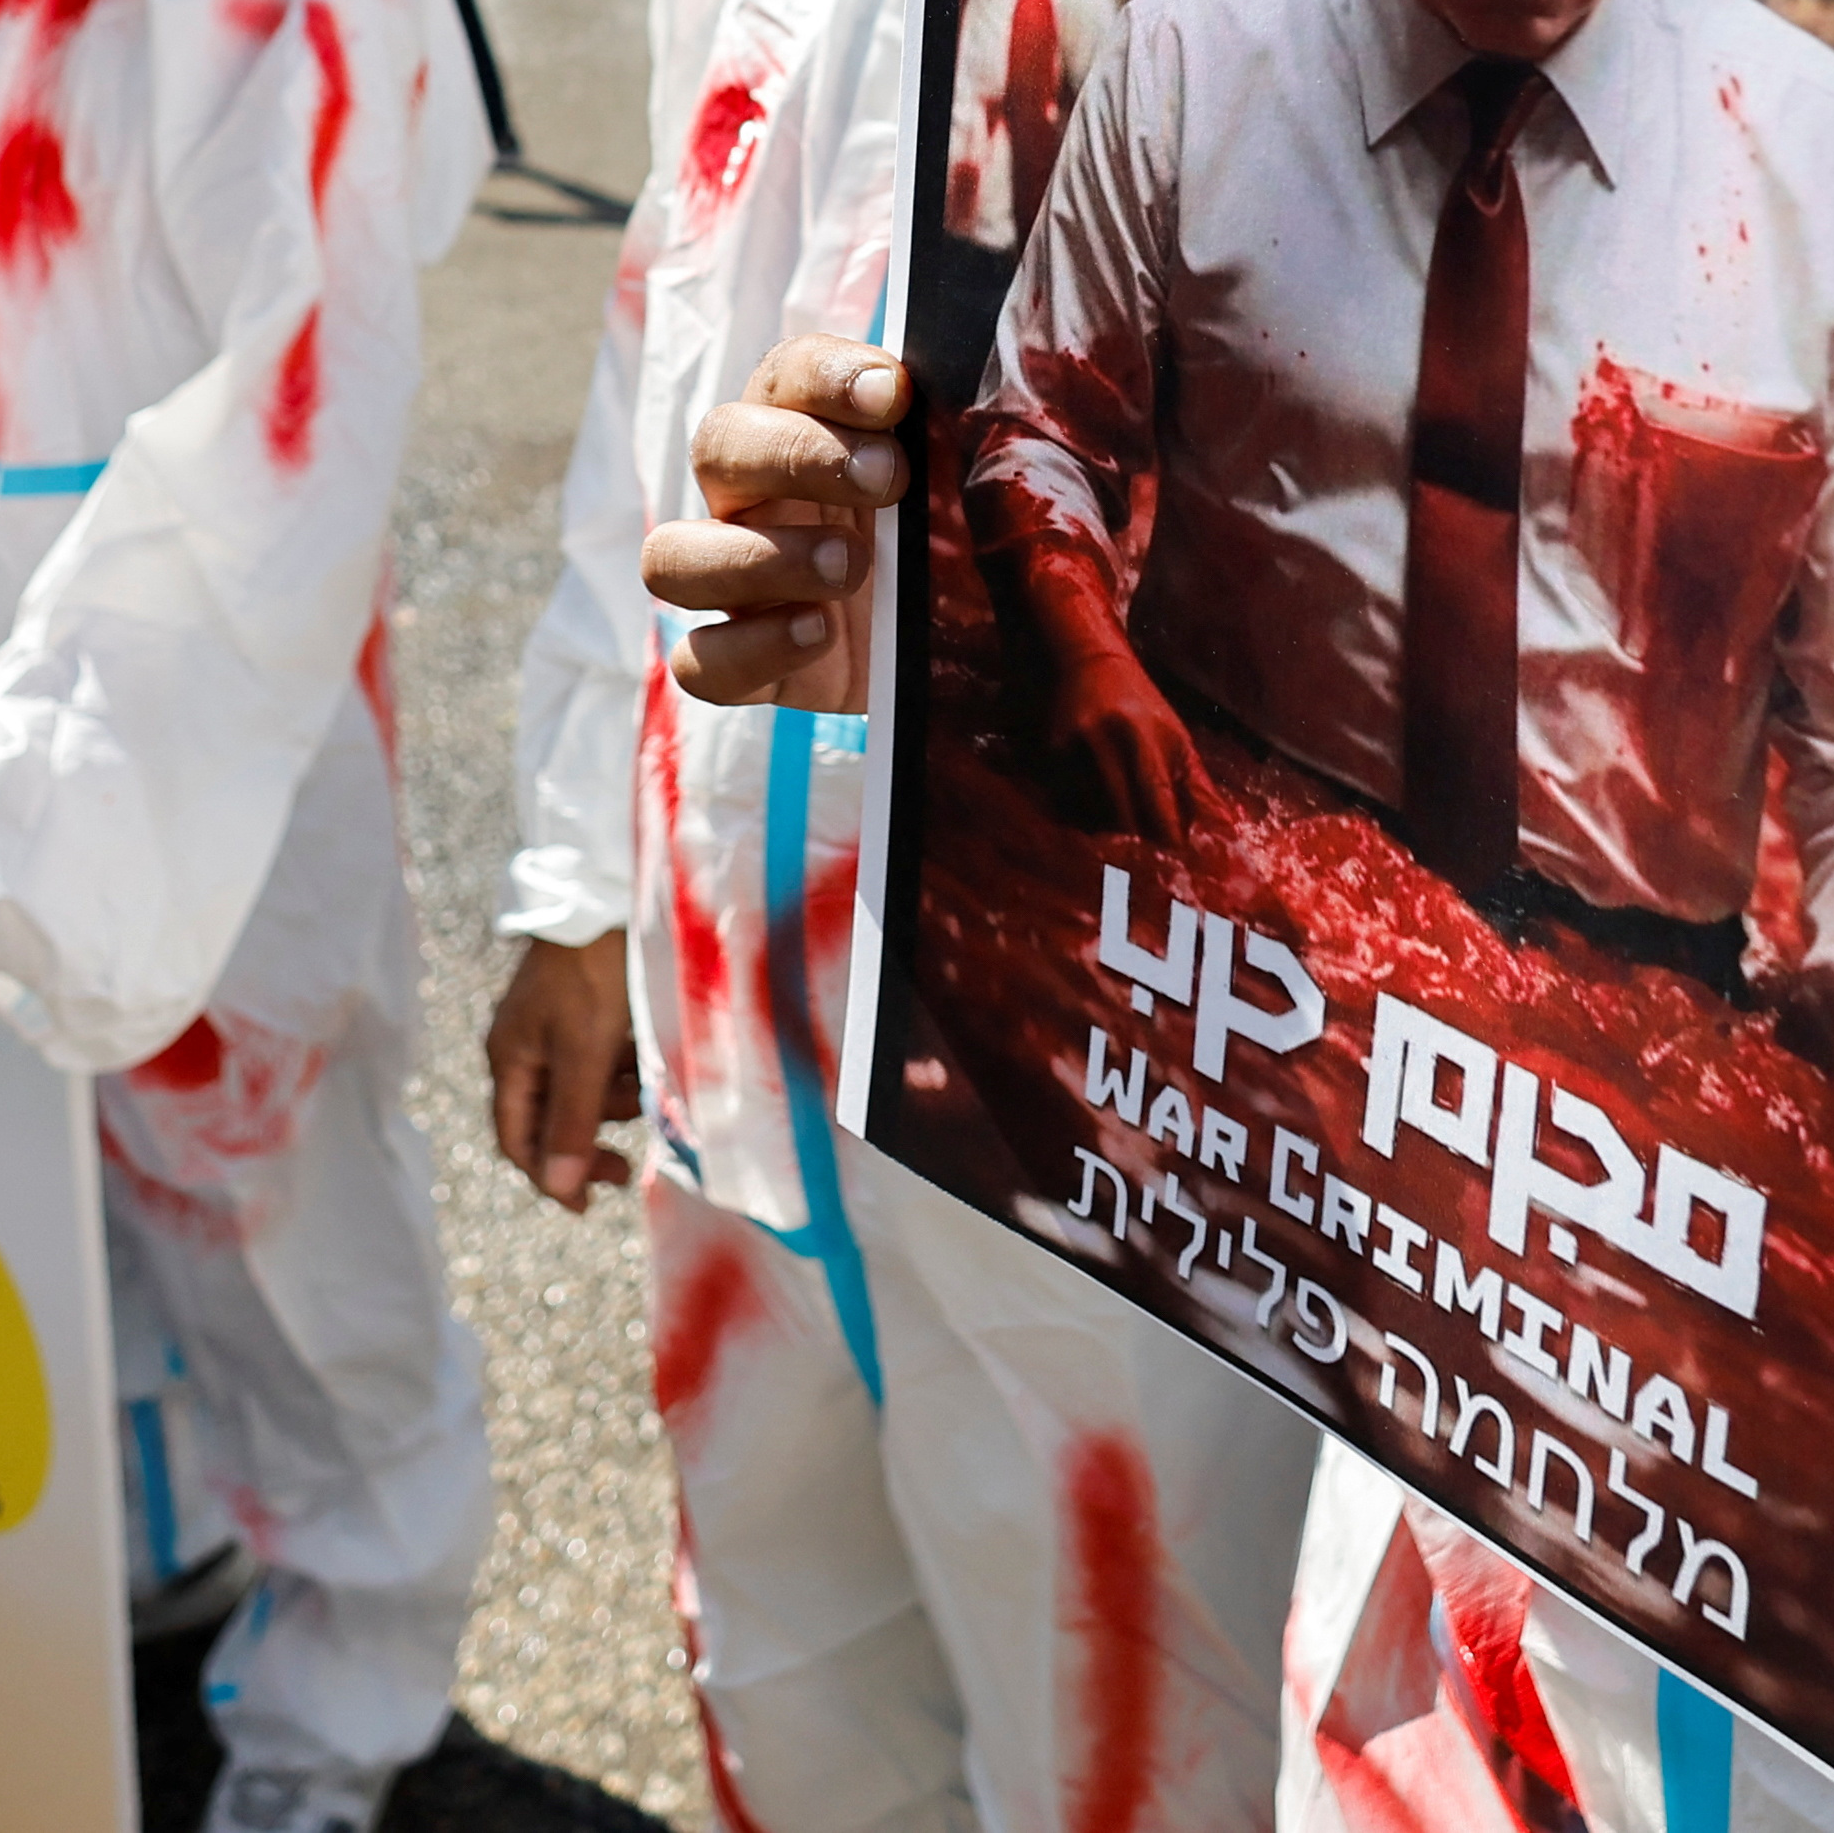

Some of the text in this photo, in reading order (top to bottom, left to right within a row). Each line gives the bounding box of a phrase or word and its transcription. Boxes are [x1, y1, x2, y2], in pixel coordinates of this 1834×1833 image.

[1083, 1026, 1762, 1502] WAR CRIMINAL
[1098, 863, 1768, 1322] مجرم حرب
[1066, 1145, 1752, 1644] מלחמה פלילית
